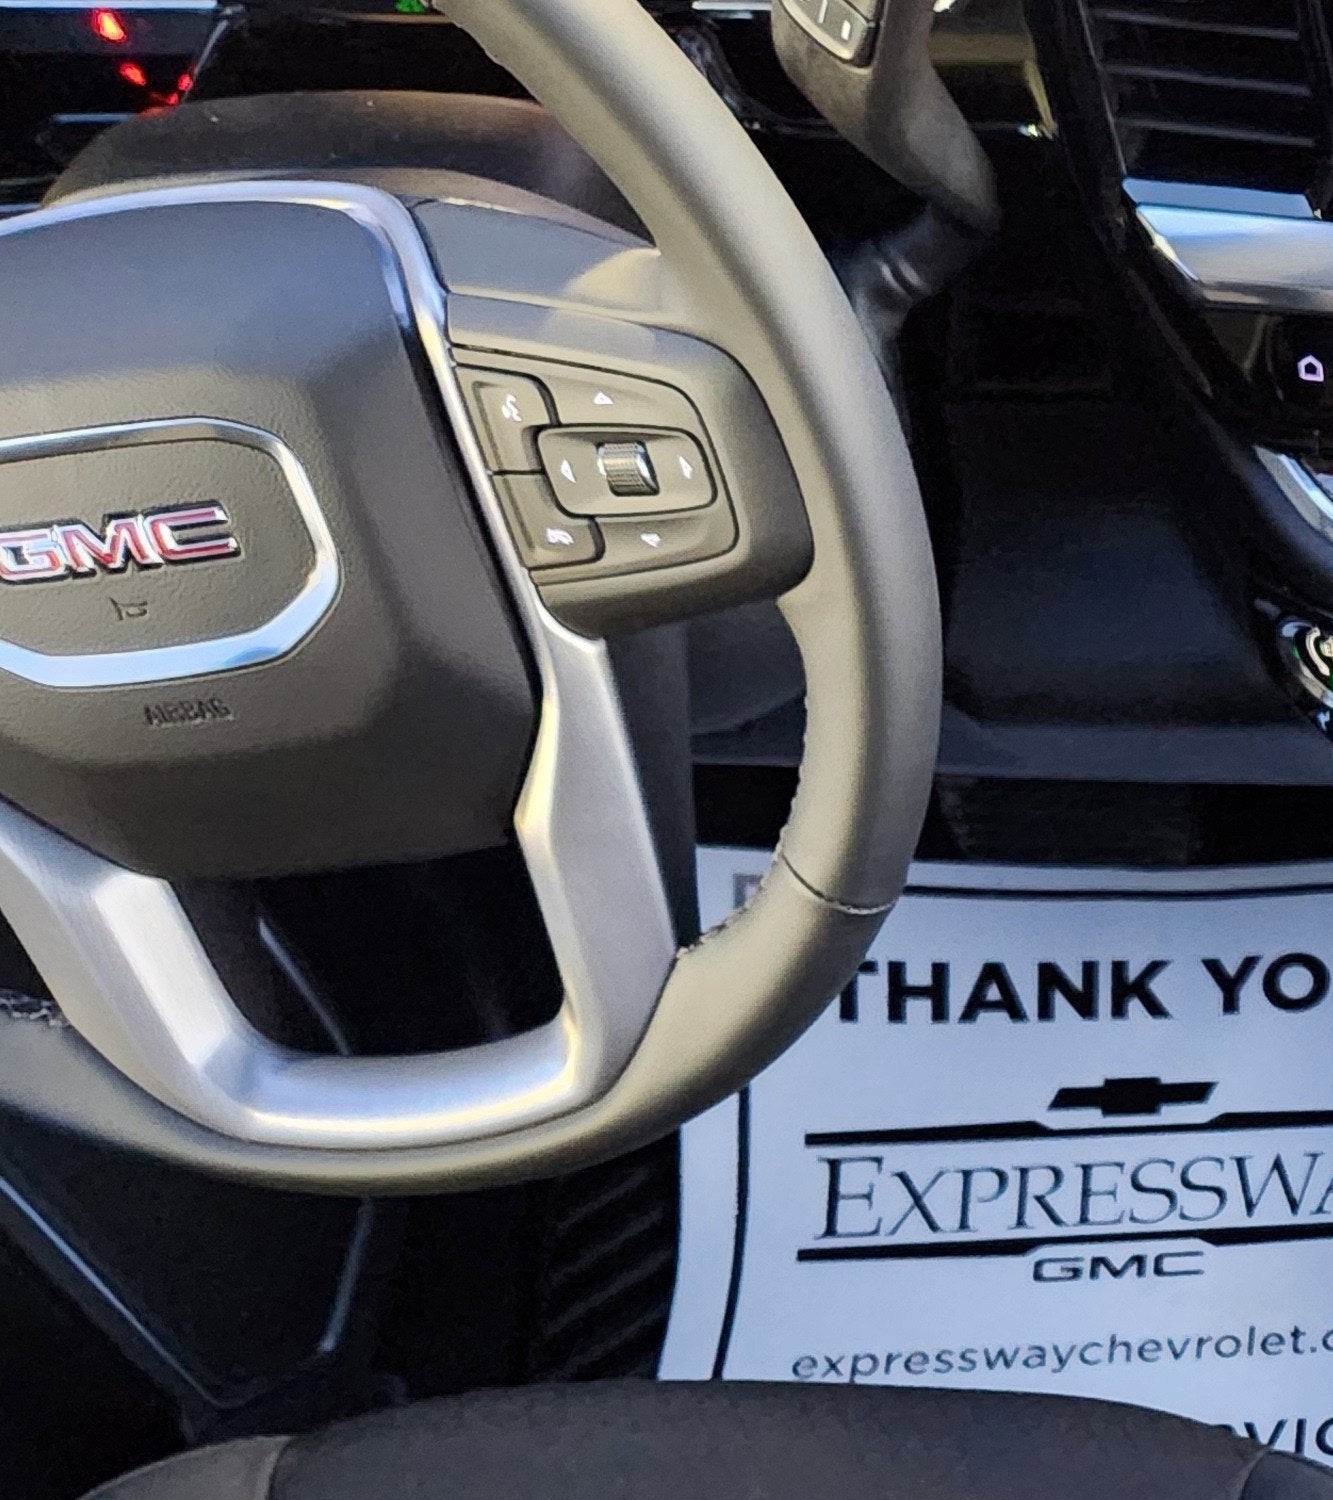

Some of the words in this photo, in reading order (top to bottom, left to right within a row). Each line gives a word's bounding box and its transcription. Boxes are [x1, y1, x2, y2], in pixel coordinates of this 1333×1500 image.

[0, 502, 241, 584] GMC
[839, 959, 1174, 1024] THANK
[1032, 1250, 1205, 1283] GMC
